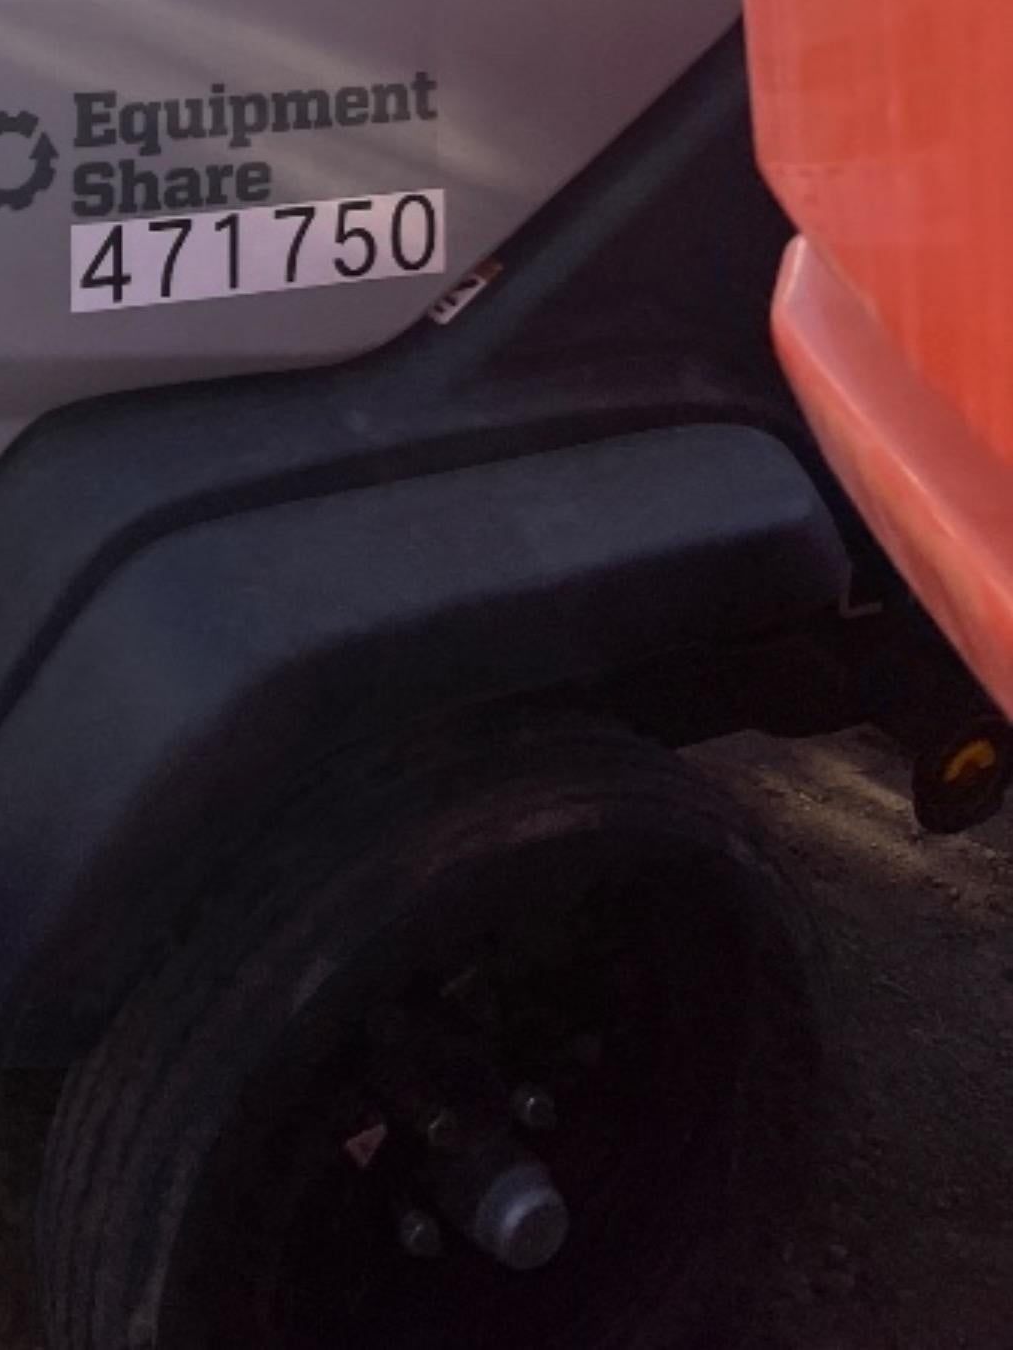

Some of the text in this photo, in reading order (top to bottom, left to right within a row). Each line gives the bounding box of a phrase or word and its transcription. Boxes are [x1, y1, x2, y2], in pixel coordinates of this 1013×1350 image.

[73, 71, 438, 156] Equipment
[72, 161, 271, 217] Share
[79, 193, 436, 304] 471750
